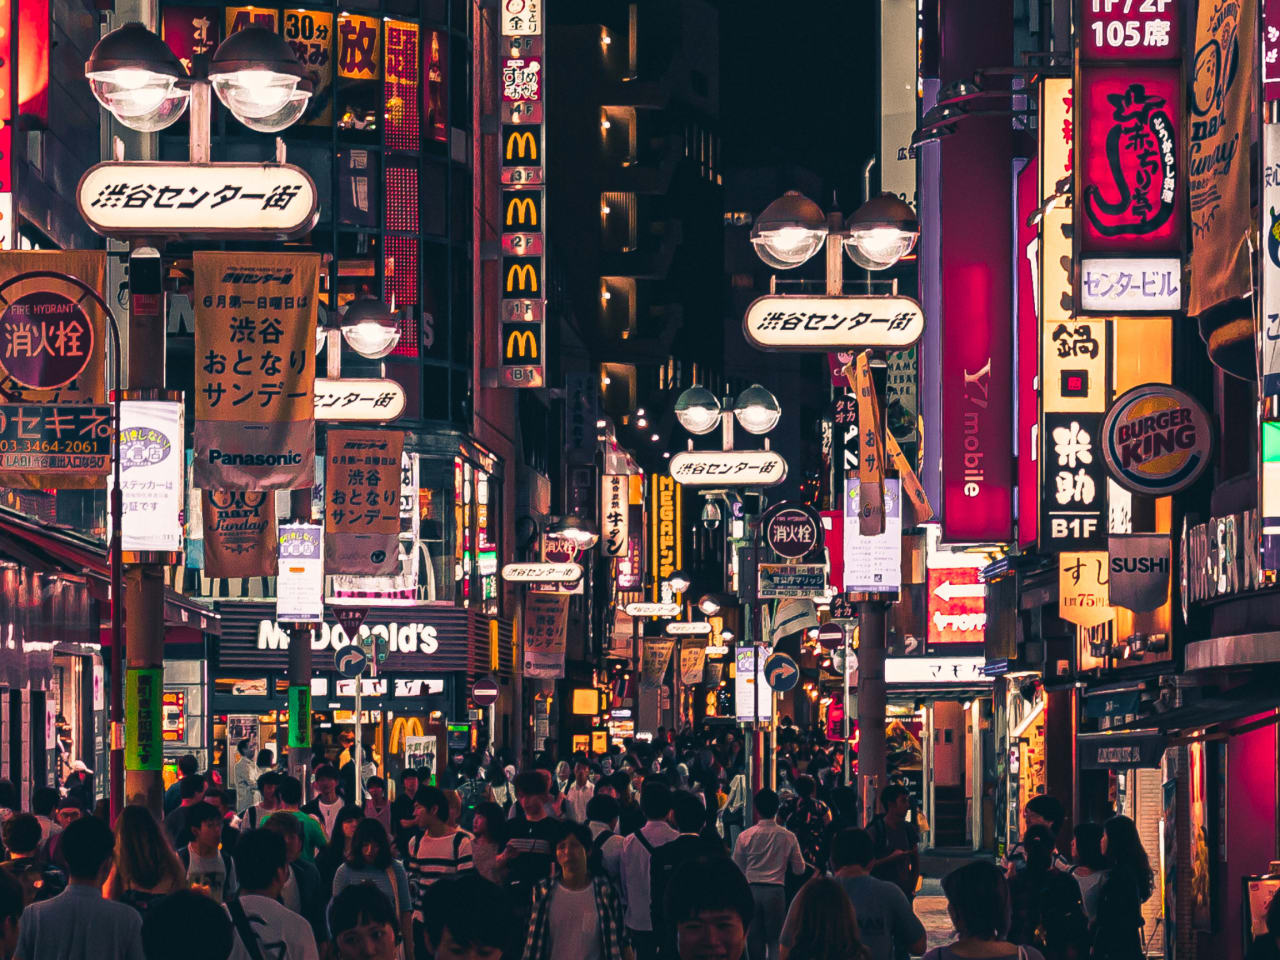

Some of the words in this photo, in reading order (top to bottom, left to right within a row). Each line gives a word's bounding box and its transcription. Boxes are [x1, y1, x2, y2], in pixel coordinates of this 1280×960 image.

[285, 13, 329, 41] 30分
[1091, 19, 1171, 48] 105席
[91, 183, 303, 211] 渋谷センター街
[1083, 270, 1179, 298] センタービル
[11, 305, 30, 315] FIRE
[33, 304, 75, 315] HYDRANT
[202, 295, 308, 310] 6月第一日曜日は
[229, 316, 285, 345] 渋谷
[756, 312, 917, 332] 渋谷センター街
[4, 320, 84, 358] 消火栓
[1053, 324, 1099, 361] 鍋
[202, 349, 306, 376] おとなり
[202, 382, 307, 408] サンデー
[1118, 408, 1193, 443] BURGER
[0, 440, 98, 453] 03-3464-2061
[208, 449, 303, 467] Panasonic
[1120, 424, 1197, 470] KING
[348, 469, 382, 487] 渋谷
[676, 460, 778, 476] 渋谷センター街
[331, 490, 396, 507] おとなり
[331, 509, 397, 525] サンデー
[1051, 518, 1098, 539] B1F
[773, 524, 812, 543] 消火栓
[1063, 557, 1109, 586] すし
[1111, 556, 1169, 574] SUSHI
